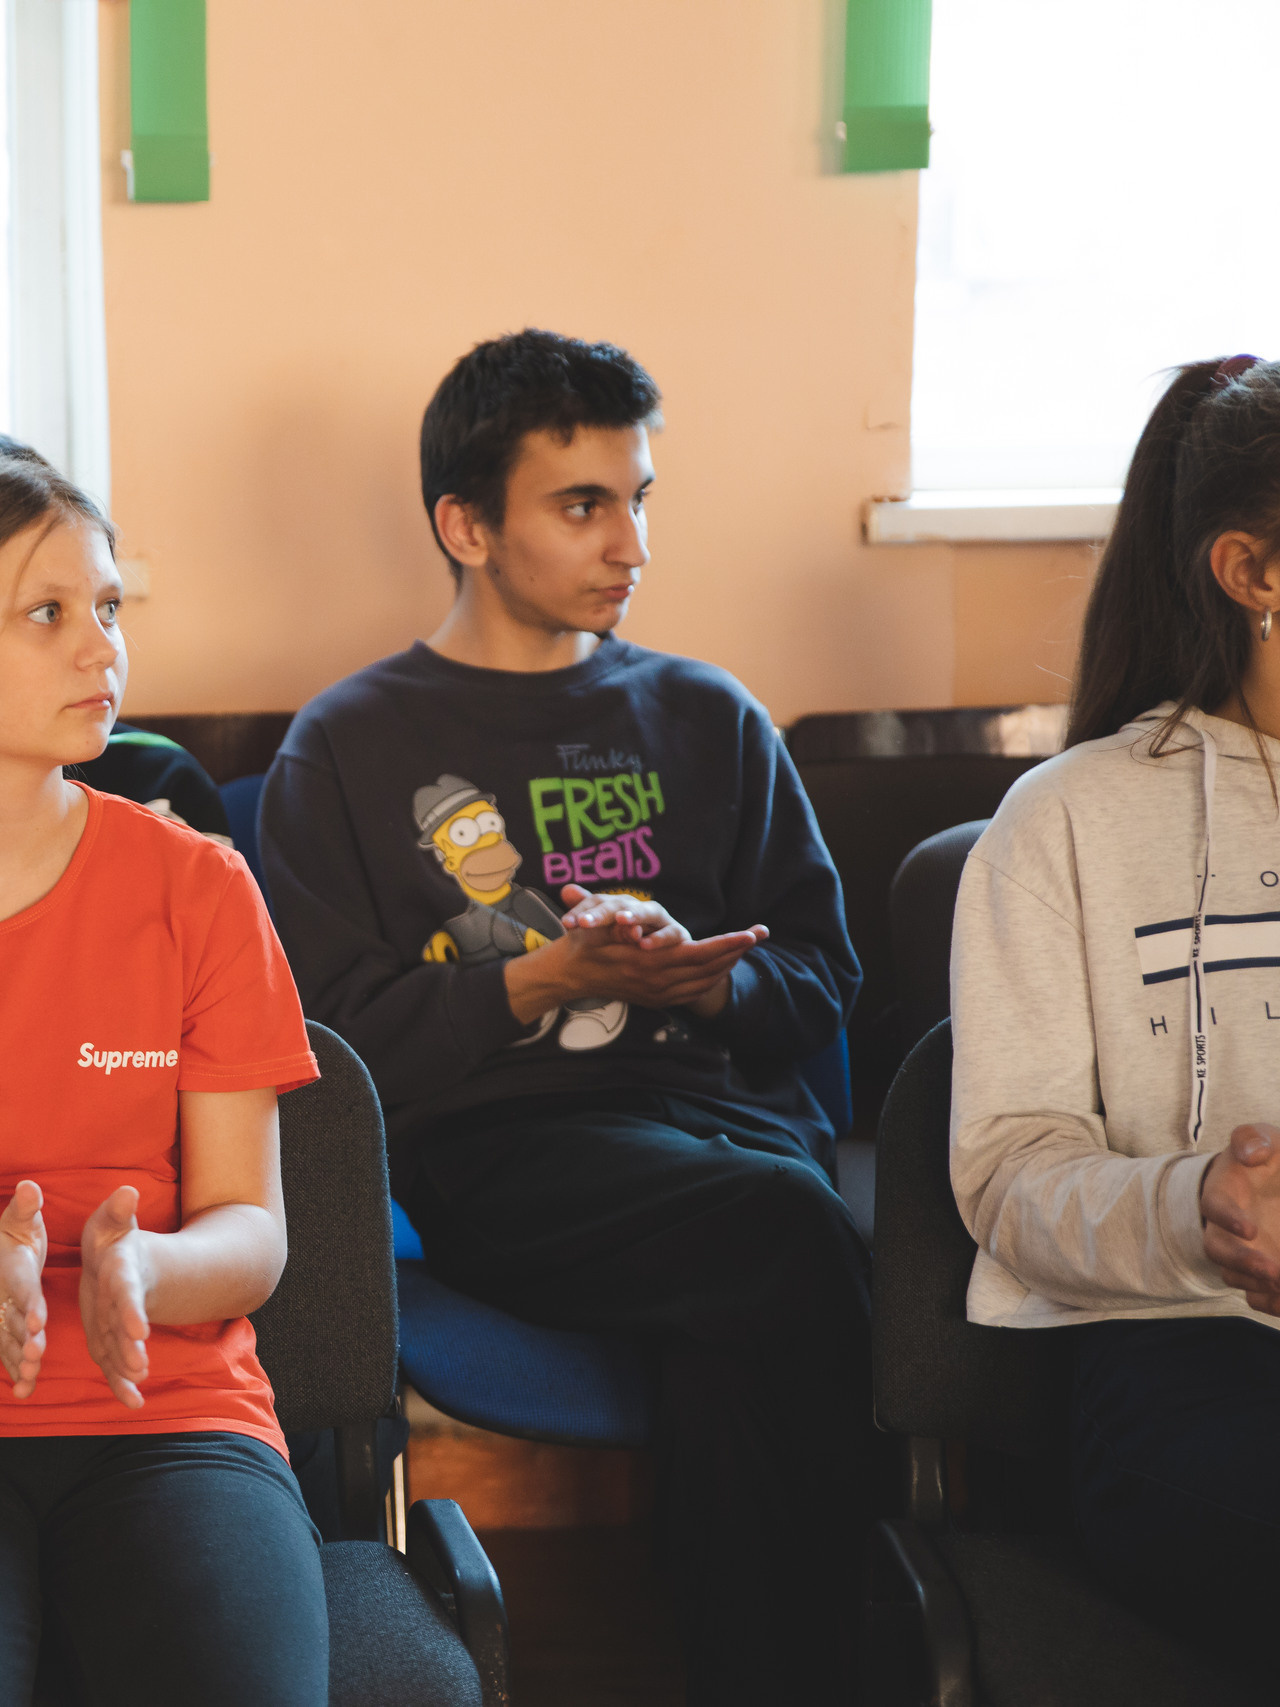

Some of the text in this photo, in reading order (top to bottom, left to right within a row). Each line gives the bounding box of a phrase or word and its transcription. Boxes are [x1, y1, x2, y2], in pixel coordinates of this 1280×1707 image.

[556, 743, 642, 774] Funky
[529, 771, 666, 853] FRESH
[1193, 912, 1202, 945] SPORTS
[77, 1042, 178, 1075] Supreme
[1195, 1034, 1207, 1066] SPORTS
